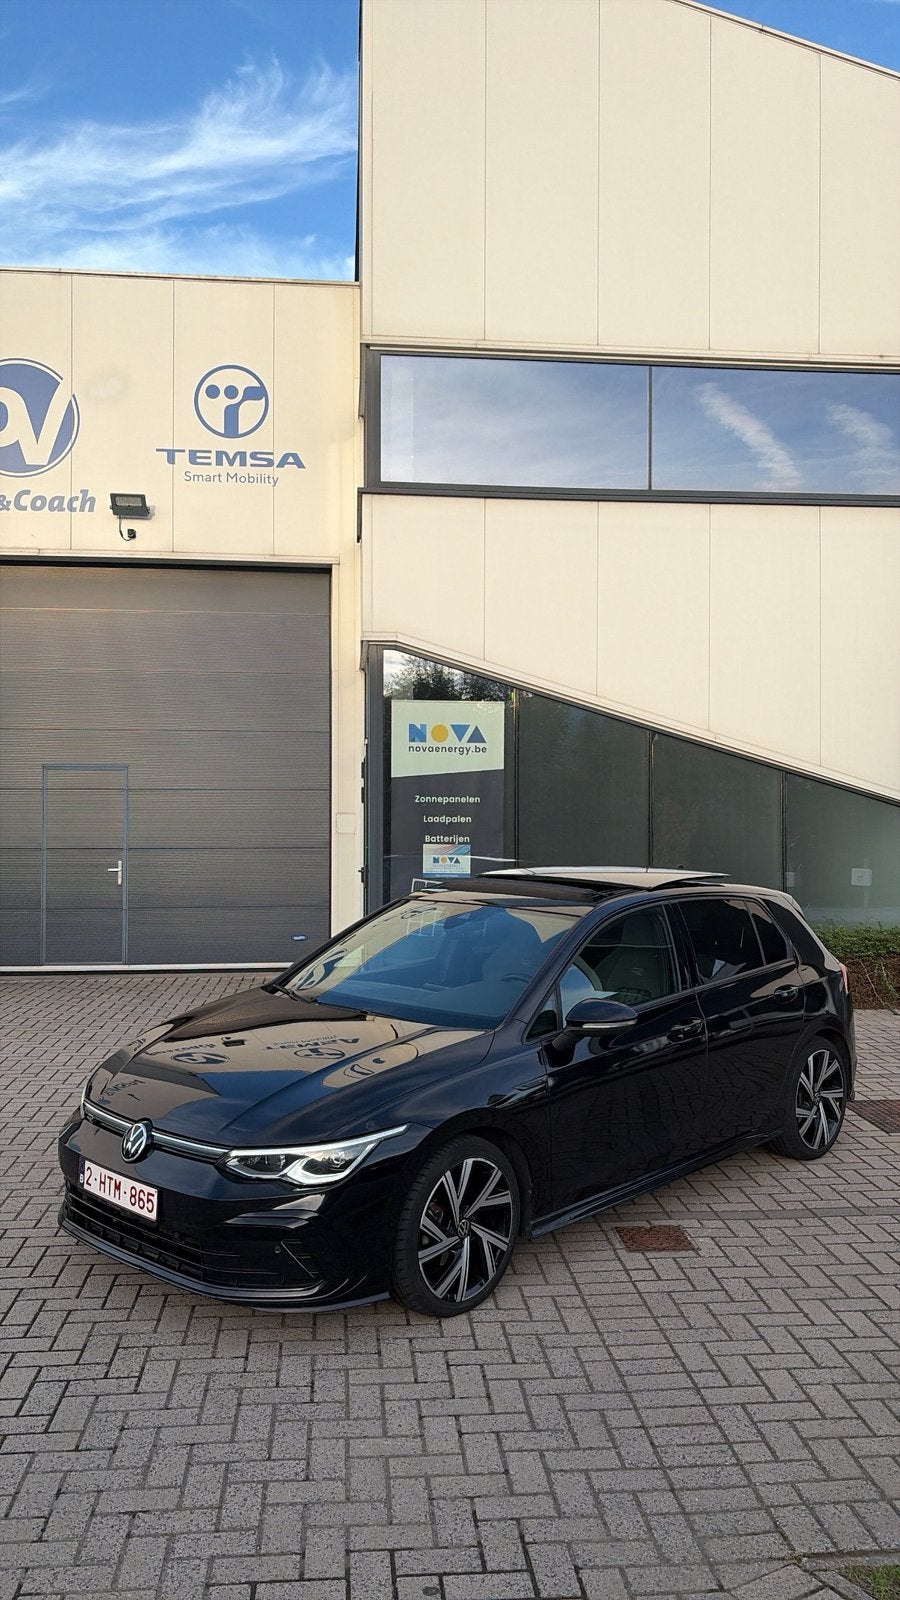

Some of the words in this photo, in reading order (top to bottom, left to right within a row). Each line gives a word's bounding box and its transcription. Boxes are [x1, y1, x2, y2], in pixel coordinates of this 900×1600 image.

[155, 448, 306, 469] TEMSA
[184, 471, 222, 483] Smart
[226, 472, 279, 487] Mobility
[408, 723, 487, 743] NOVA
[408, 745, 487, 756] novaenergy.be
[414, 795, 481, 805] Zonnepanelen
[423, 814, 472, 824] Laadpalen
[424, 834, 470, 845] Batterijen
[432, 856, 461, 864] NOVA
[85, 1166, 155, 1214] 2-HTM-865
